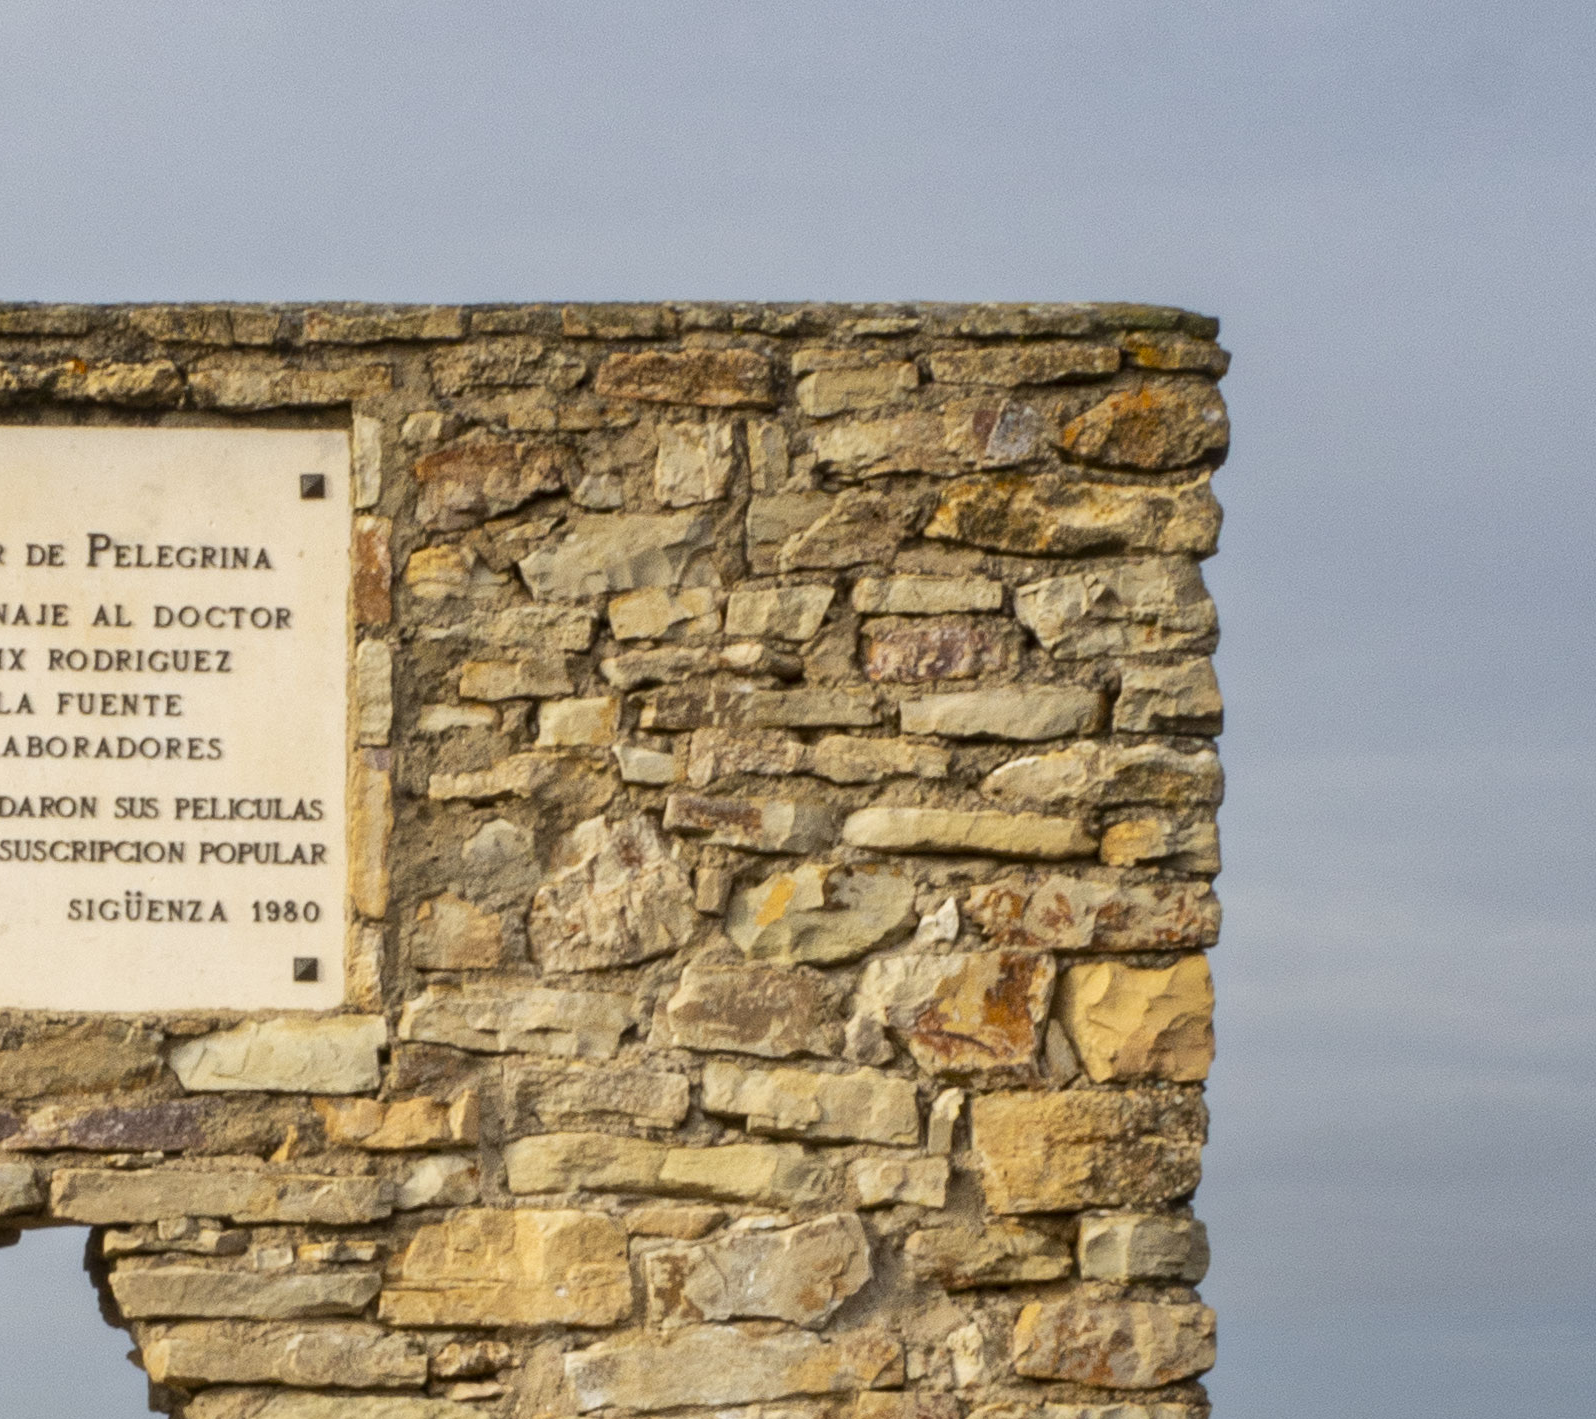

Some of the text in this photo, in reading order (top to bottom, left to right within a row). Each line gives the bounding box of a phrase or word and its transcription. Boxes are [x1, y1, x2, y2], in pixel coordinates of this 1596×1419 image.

[25, 543, 66, 568] DE
[91, 603, 133, 629] AL
[153, 605, 292, 631] DOCTOR
[47, 648, 232, 674] RODRIGUEZ
[57, 692, 183, 718] FUENTE
[114, 796, 160, 820] SUS
[174, 796, 325, 822] PELICULAS
[198, 841, 327, 866] POPULAR
[67, 889, 322, 924] SIGÜENZA 1980
